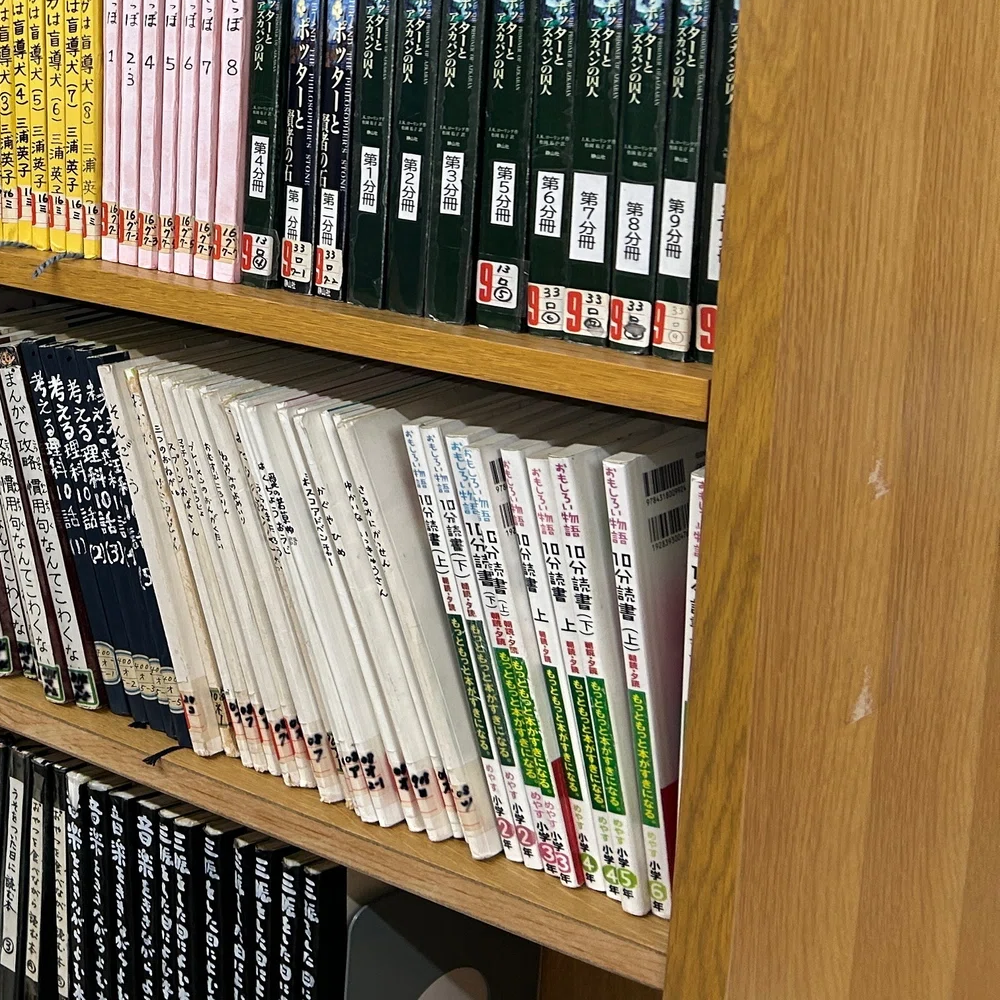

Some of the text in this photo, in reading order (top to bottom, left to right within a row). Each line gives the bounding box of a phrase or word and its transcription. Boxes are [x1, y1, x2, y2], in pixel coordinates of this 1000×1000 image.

[250, 140, 267, 193] 第4分冊
[361, 152, 378, 206] 第1分冊
[401, 158, 418, 212] 第2分冊
[442, 156, 461, 212] 第3分冊
[495, 166, 513, 223] 第5分冊
[539, 176, 559, 233] 第6分冊
[578, 192, 598, 250] 第7分冊
[624, 202, 644, 261] 第8分冊
[666, 199, 685, 258] 第9分冊
[405, 428, 428, 489] おもしろい物語
[426, 434, 451, 494] おもしろい物語
[419, 494, 440, 547] 10分読書
[439, 499, 465, 553] 10分読書
[531, 466, 555, 537] おもしろい物語
[555, 462, 580, 538] おもしろい物語
[605, 467, 629, 546] おもしろい物語
[543, 542, 567, 604] 10分読書
[566, 545, 592, 611] 10分読書
[612, 552, 637, 622] 10分読書
